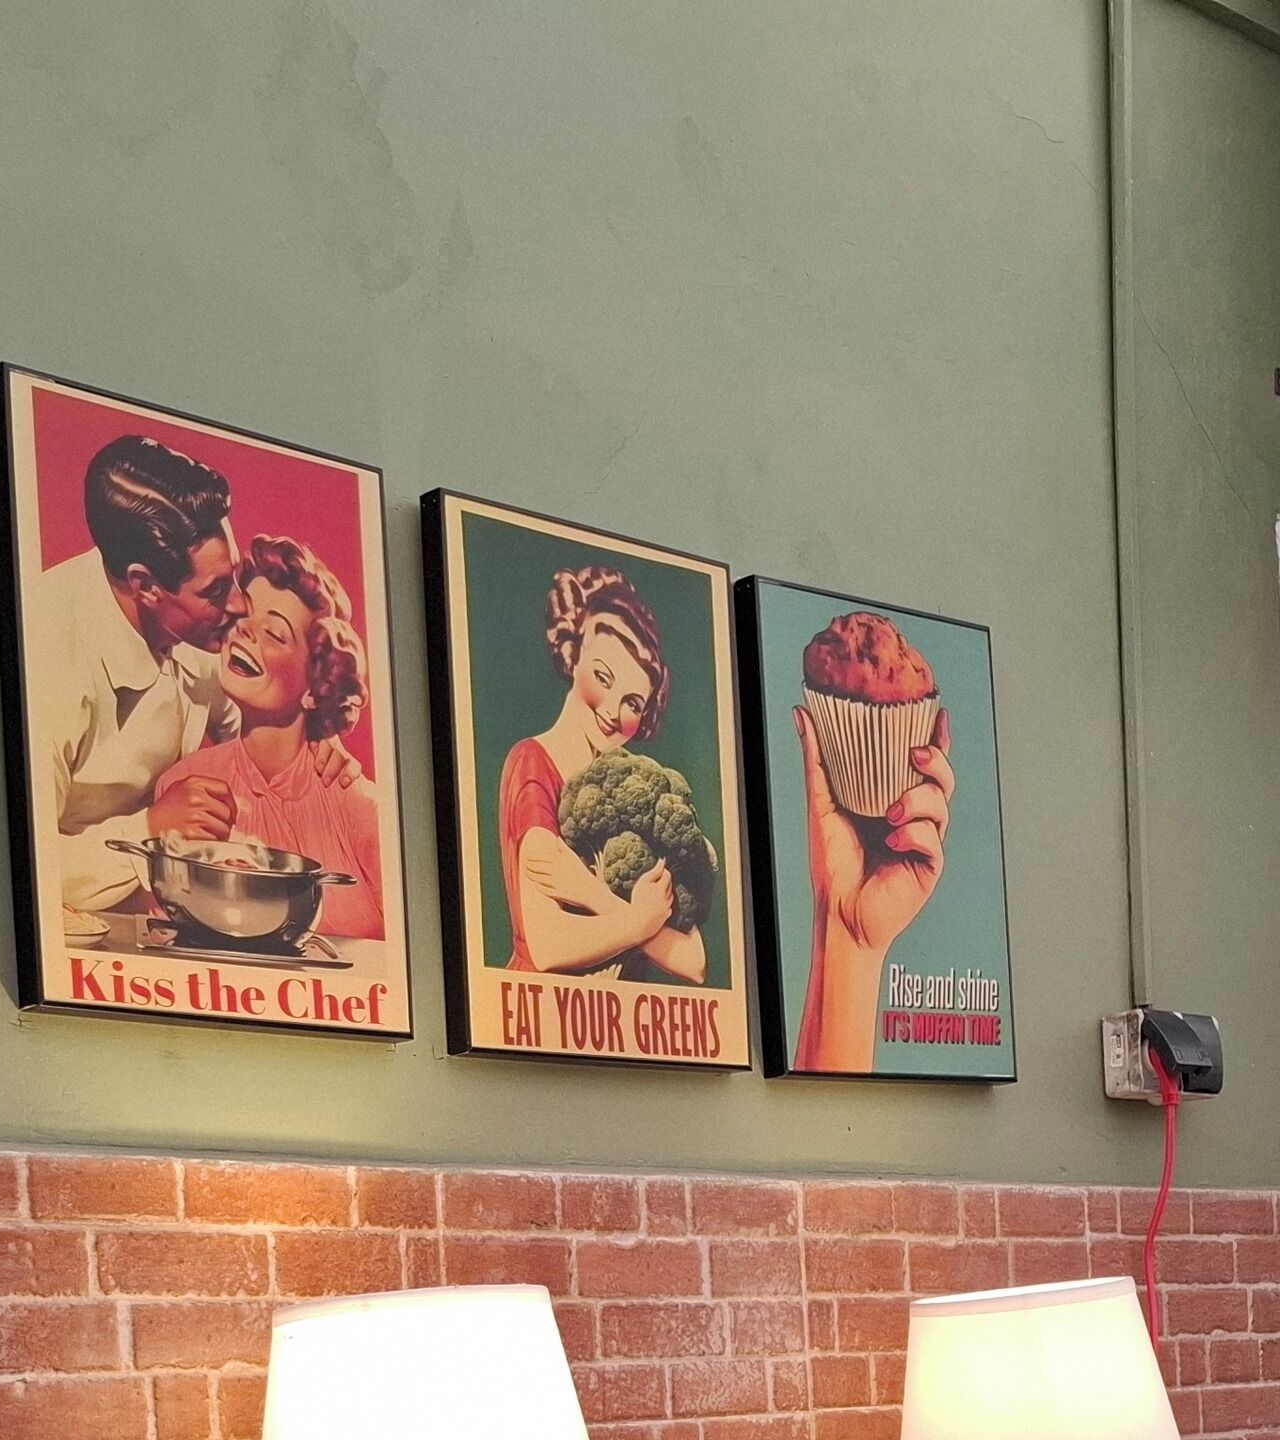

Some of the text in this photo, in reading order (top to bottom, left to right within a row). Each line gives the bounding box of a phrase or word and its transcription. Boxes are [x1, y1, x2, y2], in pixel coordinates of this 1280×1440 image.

[68, 957, 388, 1025] Kiss the Chef
[888, 963, 1000, 1012] Rise and shine
[501, 981, 721, 1058] EAT YOUR GREENS
[911, 1012, 966, 1044] MUFFIN
[966, 1014, 1002, 1046] TIME
